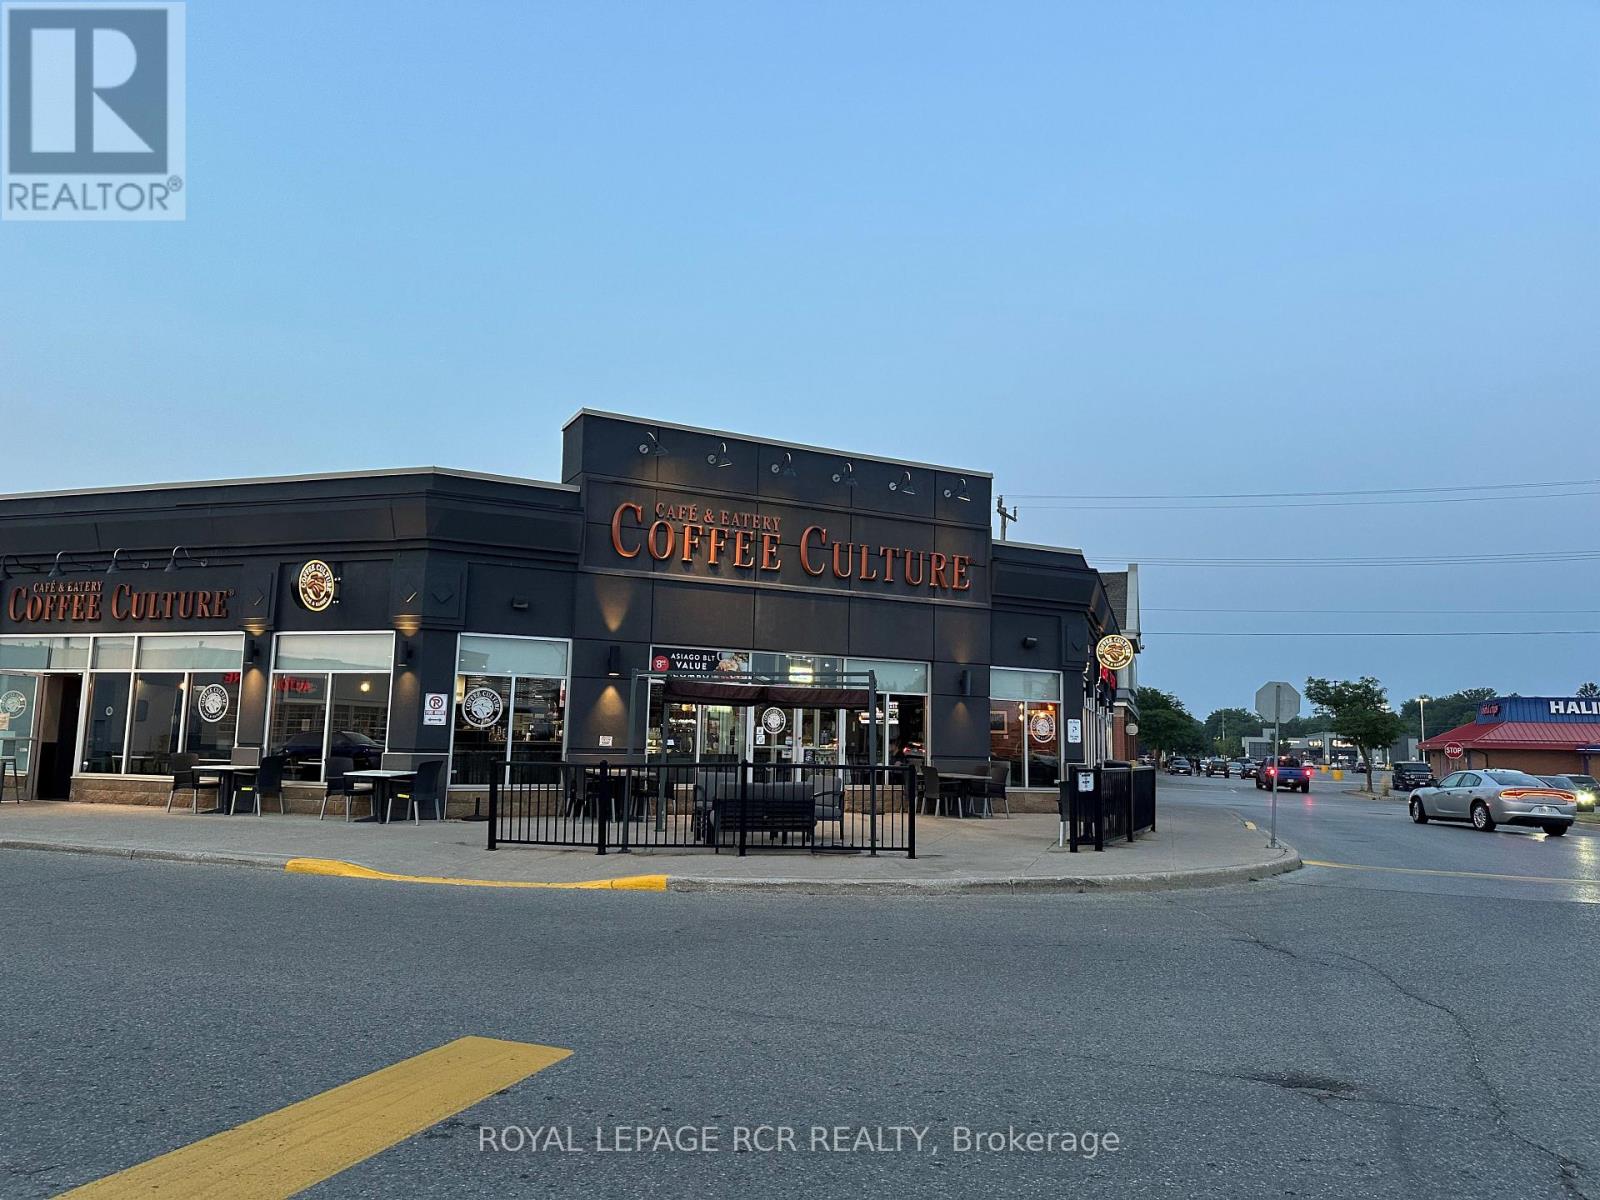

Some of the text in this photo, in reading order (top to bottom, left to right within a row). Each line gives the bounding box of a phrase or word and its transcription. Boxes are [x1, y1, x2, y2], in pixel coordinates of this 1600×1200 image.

[655, 503, 781, 532] CAFÉ & EATERY
[611, 502, 971, 590] COFFEE CULTURE
[58, 583, 65, 592] &
[67, 580, 103, 593] EATERY
[8, 585, 102, 623] COFFEE
[670, 652, 701, 660] ASIAGO
[675, 661, 708, 671] VALUE
[1550, 700, 1600, 715] HALI
[1446, 746, 1462, 754] STOP
